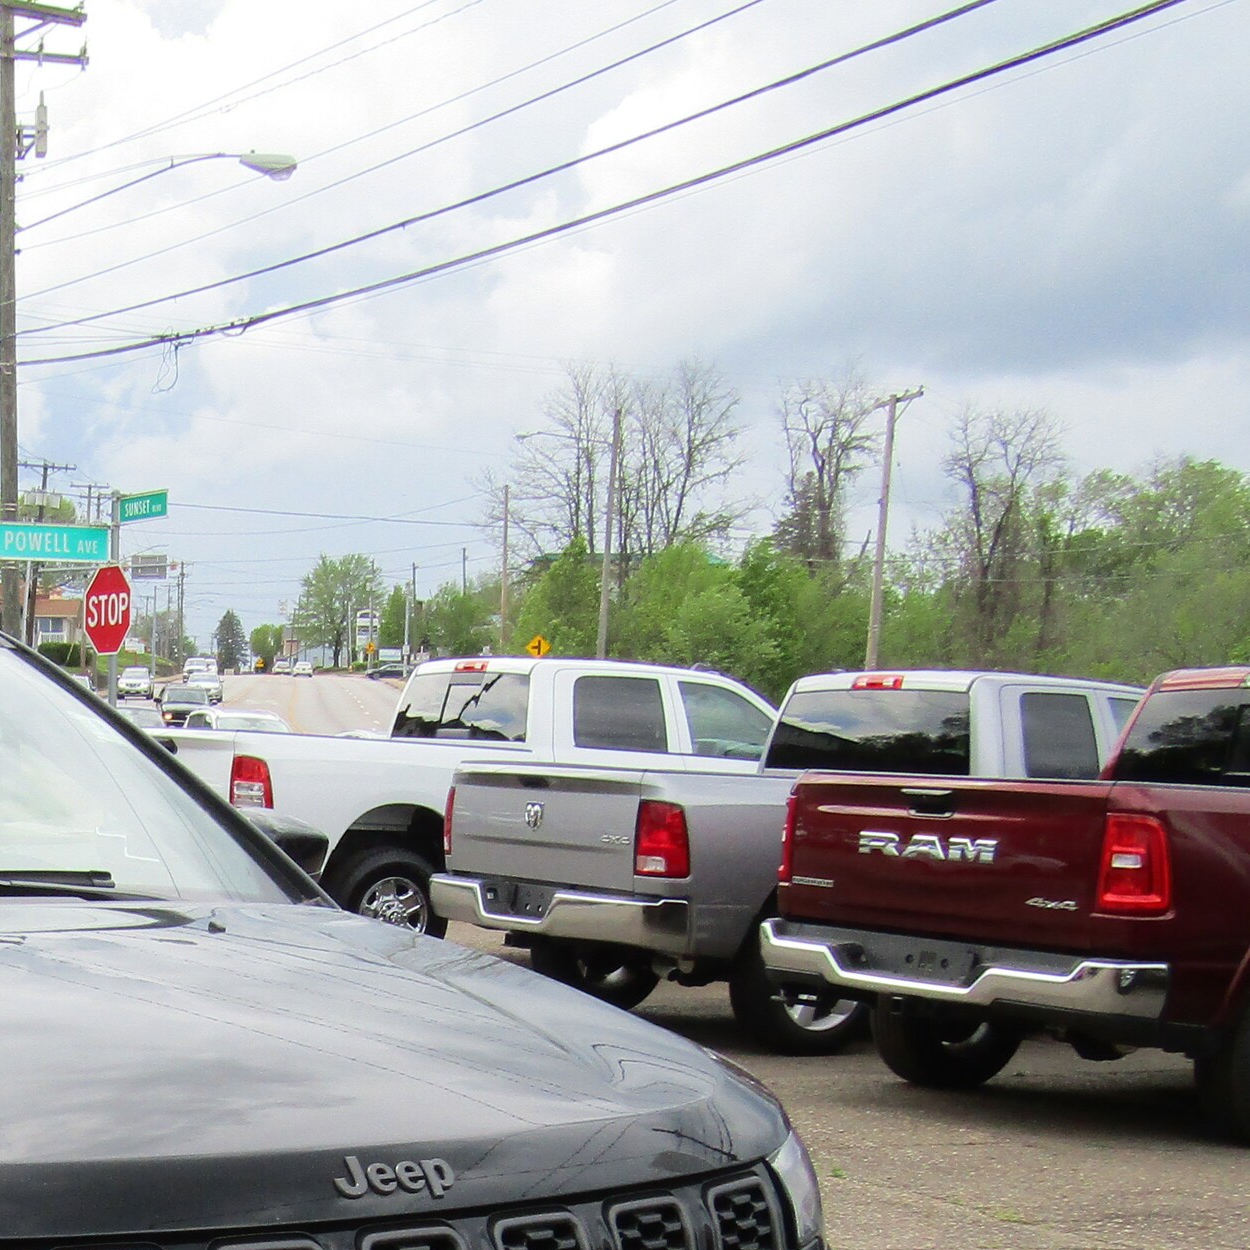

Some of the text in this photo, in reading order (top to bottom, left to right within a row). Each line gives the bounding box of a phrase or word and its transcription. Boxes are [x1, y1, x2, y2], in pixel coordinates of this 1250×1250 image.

[124, 499, 150, 517] SUNSET
[5, 531, 98, 554] POWELL AVE
[87, 592, 129, 628] STOP
[857, 830, 999, 865] RAM
[333, 1155, 455, 1200] Jeep
